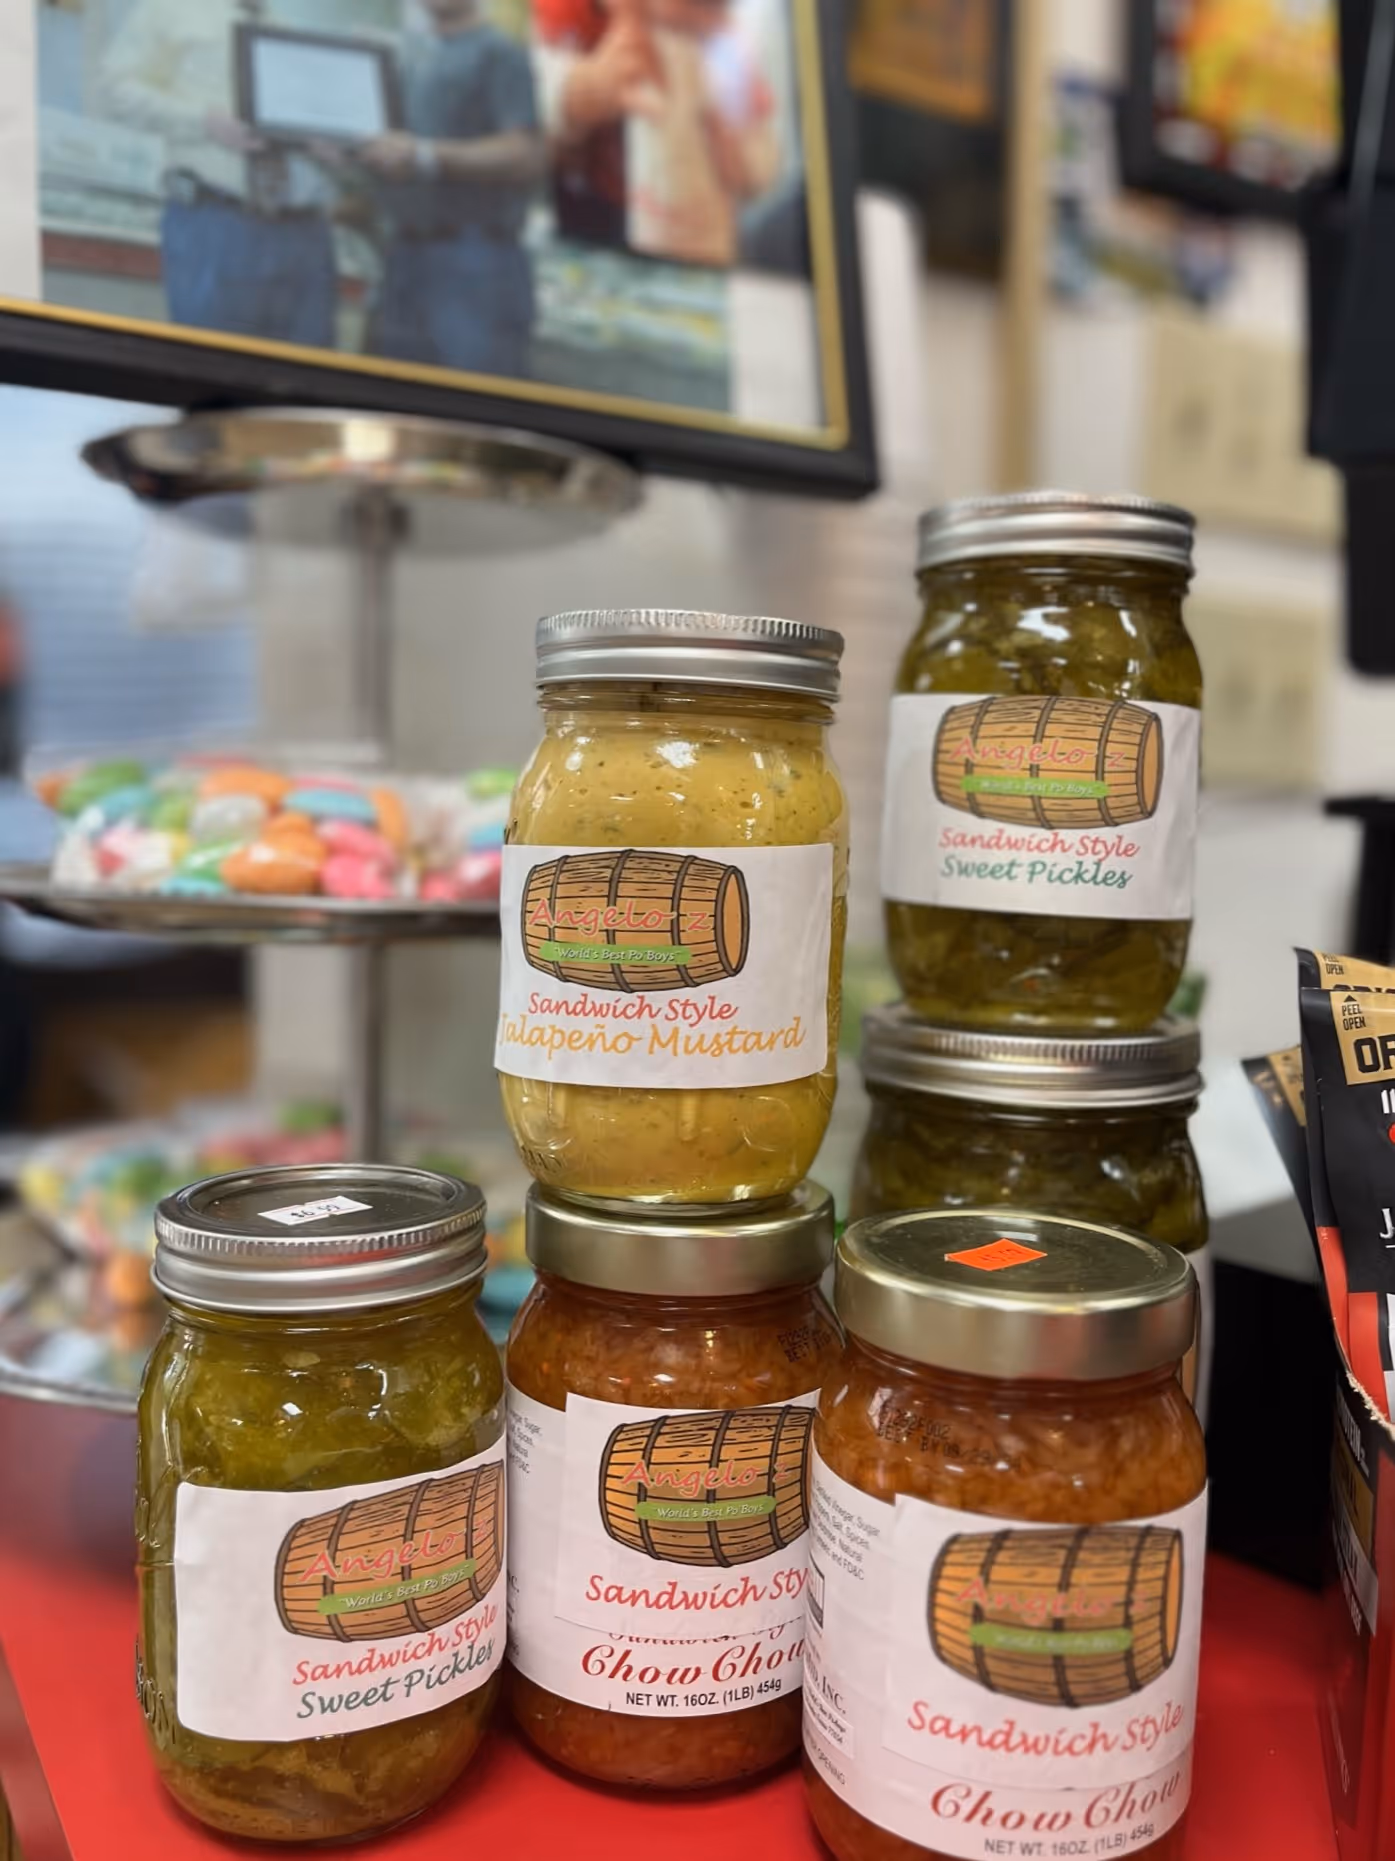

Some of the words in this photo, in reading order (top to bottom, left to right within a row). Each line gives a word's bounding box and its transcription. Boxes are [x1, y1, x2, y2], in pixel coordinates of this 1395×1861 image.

[938, 828, 1073, 853] Sandwich
[1076, 835, 1140, 862] Style
[940, 855, 1022, 880] Sweet
[1027, 860, 1134, 889] Pickles
[529, 899, 673, 937] Angelo
[601, 949, 626, 960] Best
[528, 992, 661, 1020] Sandwich
[665, 995, 740, 1027] Style
[1342, 1004, 1362, 1017] PEEL
[1343, 1016, 1367, 1031] OPEN
[499, 1014, 642, 1060] Jalapeño
[648, 1016, 807, 1058] Mustard
[621, 1459, 763, 1498] Angelo
[702, 1507, 722, 1518] Best
[300, 1529, 465, 1582] Angelo
[396, 1583, 420, 1598] Best
[585, 1574, 767, 1610] Sandwich
[293, 1631, 450, 1686] Sandwich
[452, 1603, 498, 1646] Style
[296, 1676, 400, 1719] Sweet
[404, 1638, 496, 1698] Pickles
[581, 1643, 703, 1685] Chow
[626, 1691, 653, 1706] NET
[656, 1693, 679, 1707] WT.
[684, 1692, 719, 1707] 16OZ.
[723, 1685, 754, 1706] (1LB)
[757, 1678, 782, 1694] 454g
[907, 1699, 1118, 1757] Sandwich
[1121, 1700, 1183, 1751] Style
[931, 1782, 1072, 1832] Chow
[1084, 1771, 1180, 1829] Chow
[984, 1838, 1015, 1856] NET
[1019, 1840, 1047, 1857] WT.
[1094, 1832, 1127, 1855] (1LB)
[1130, 1823, 1154, 1841] 454g
